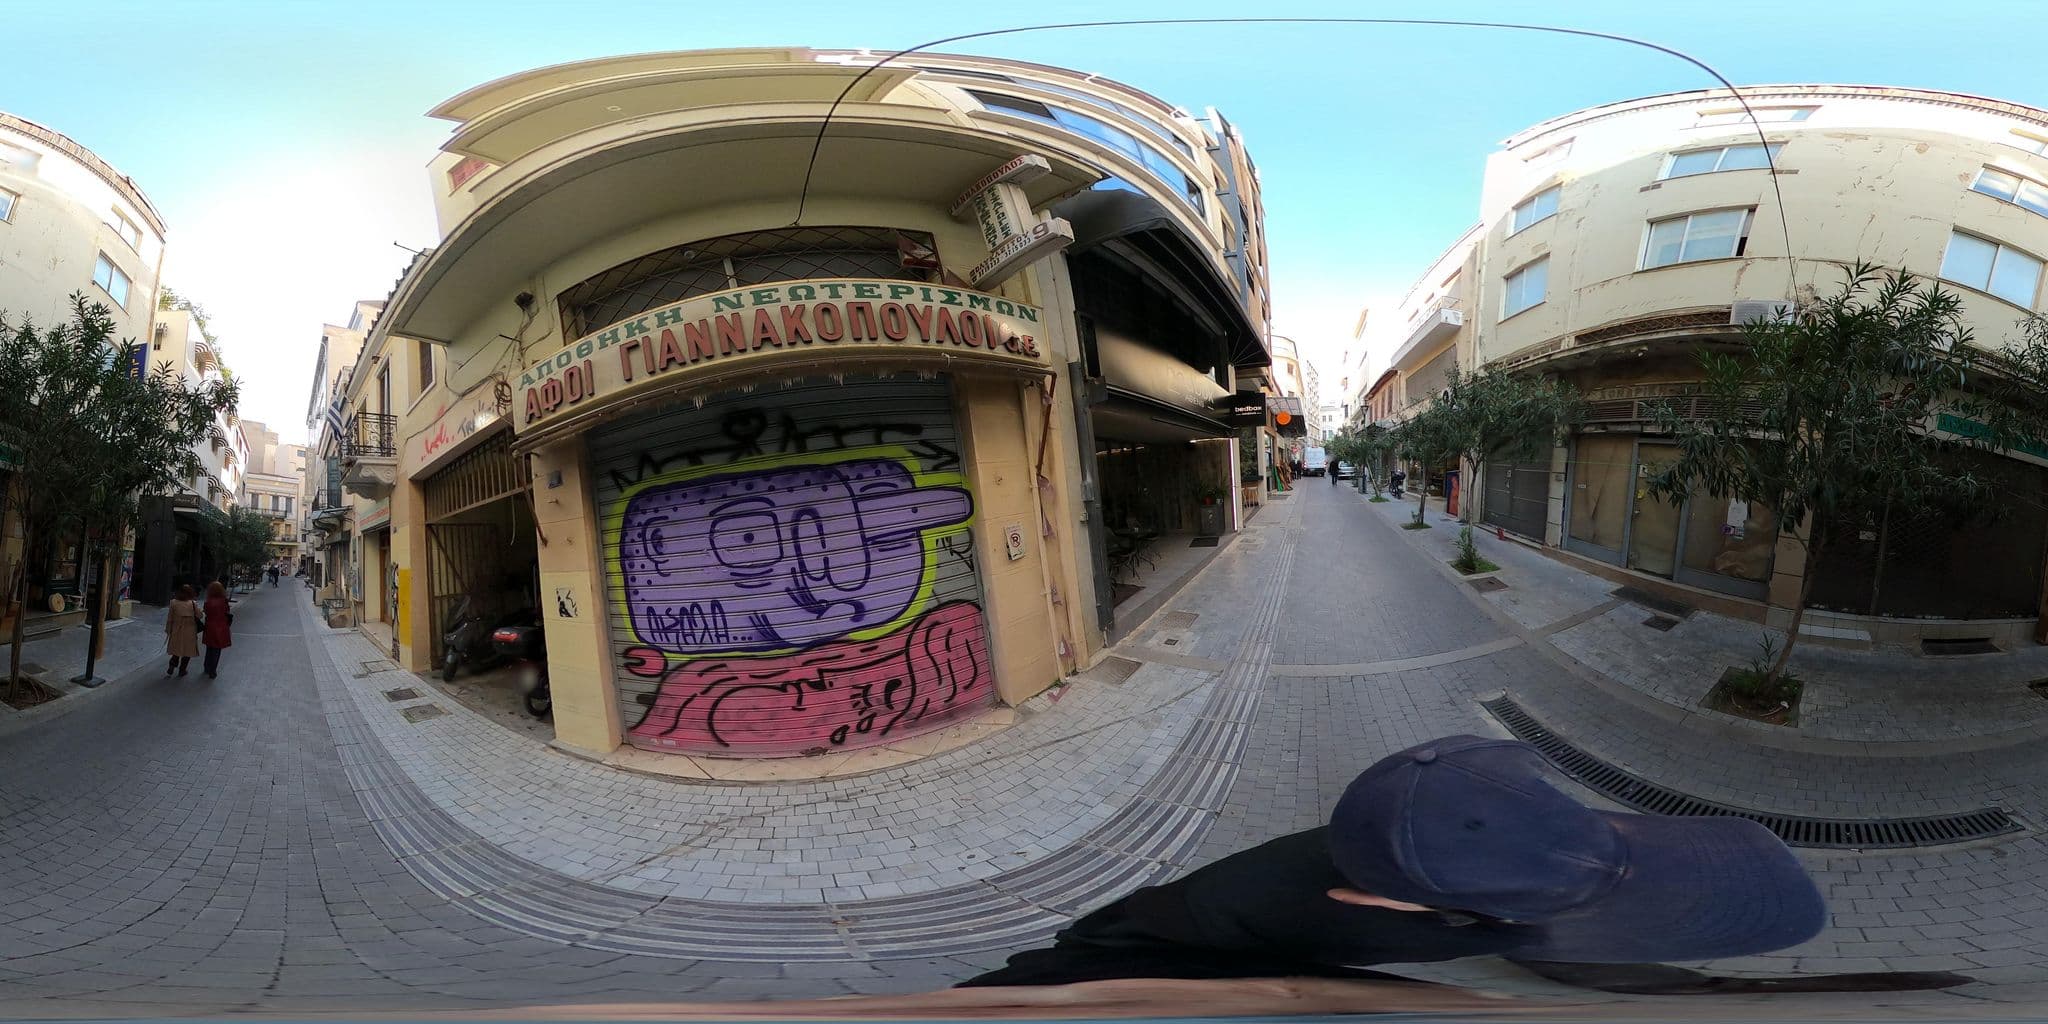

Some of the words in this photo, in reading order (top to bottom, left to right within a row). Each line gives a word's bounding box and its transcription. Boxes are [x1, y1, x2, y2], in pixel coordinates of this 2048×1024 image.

[1032, 222, 1049, 239] 9
[518, 306, 683, 391] ΑΠΟΘΗΚΗ
[712, 283, 1038, 323] ΝΕΩΤΕΡΙΣΜΩΝ
[524, 359, 595, 424] ΑΦΟΙ
[619, 301, 998, 382] ΓΙΑΝΝΑΚΟΠΟΥΛΟΙ
